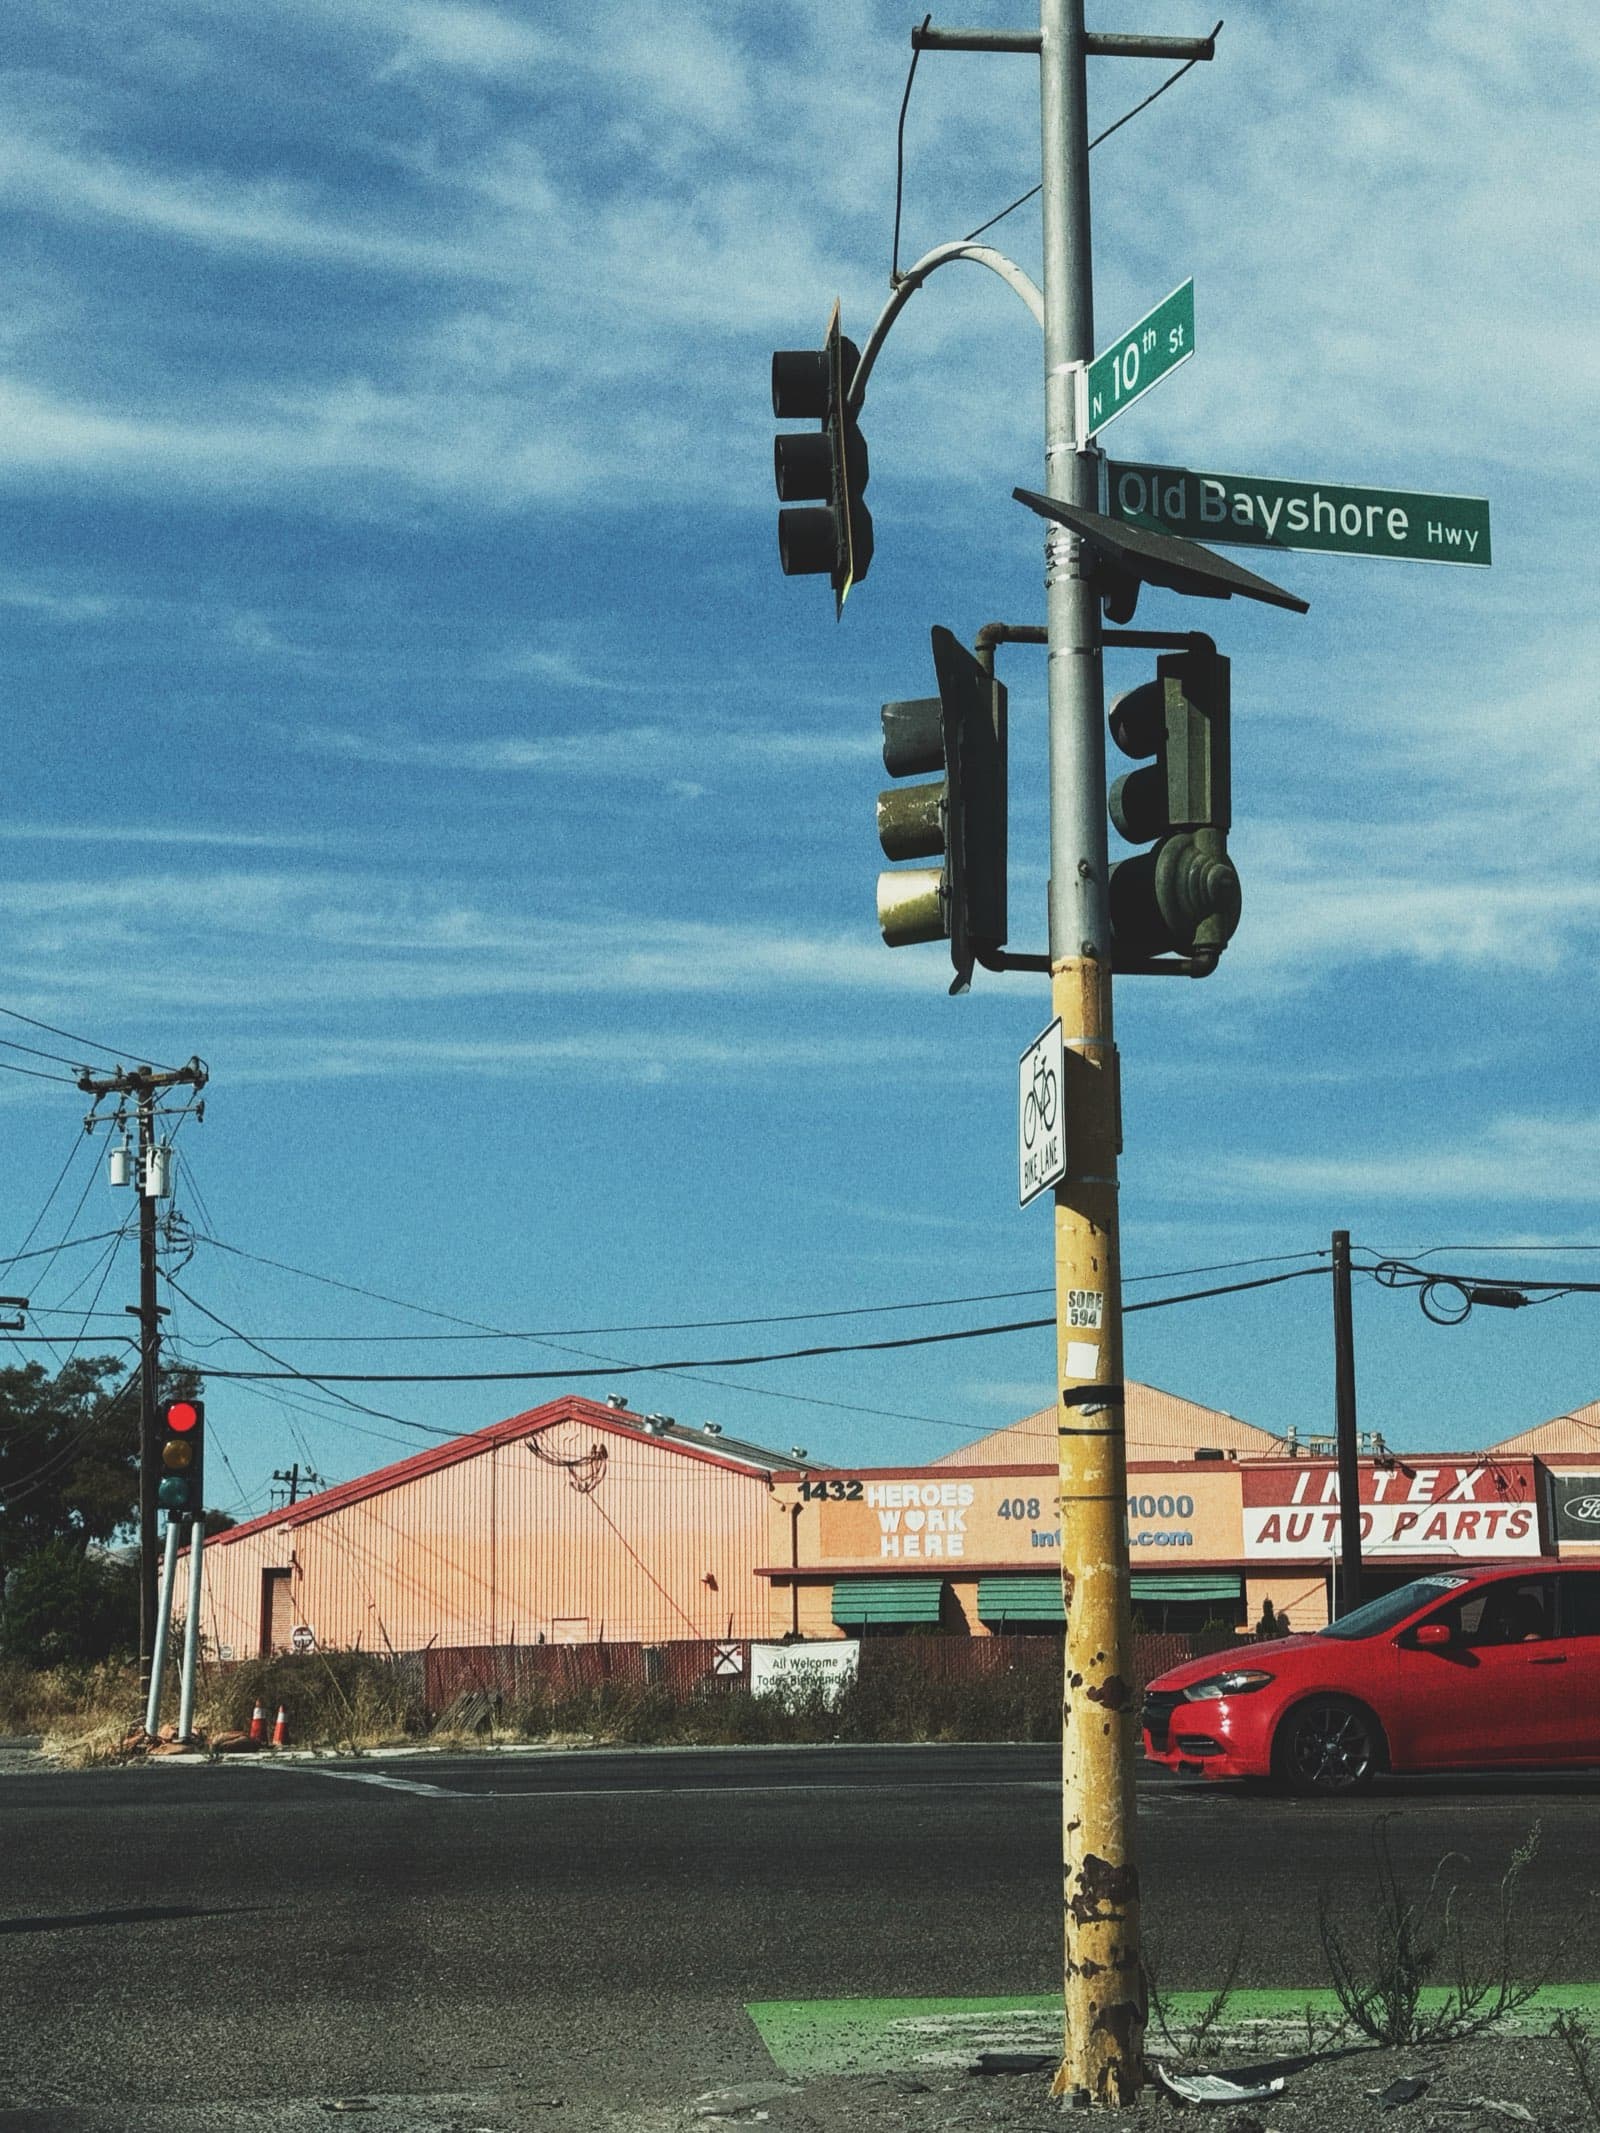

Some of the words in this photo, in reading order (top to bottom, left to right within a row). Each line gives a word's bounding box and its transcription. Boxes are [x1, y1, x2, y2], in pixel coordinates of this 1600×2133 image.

[1093, 391, 1102, 419] N
[1168, 323, 1184, 354] St
[1118, 471, 1186, 519] Old
[1200, 479, 1409, 541] Bayshore
[1427, 521, 1478, 552] Hwy
[1024, 1151, 1038, 1190] BIKE
[1040, 1135, 1058, 1176] LANE
[1068, 1290, 1102, 1310] SORE
[1070, 1308, 1098, 1328] 594
[797, 1480, 864, 1502] 1432
[867, 1483, 975, 1509] HEROES
[998, 1498, 1041, 1520] 408
[1392, 1509, 1533, 1542] PARTS
[880, 1534, 965, 1558] HERE
[772, 1657, 786, 1669] All
[790, 1656, 838, 1669] Welcome
[790, 1672, 850, 1686] Bienvenido
